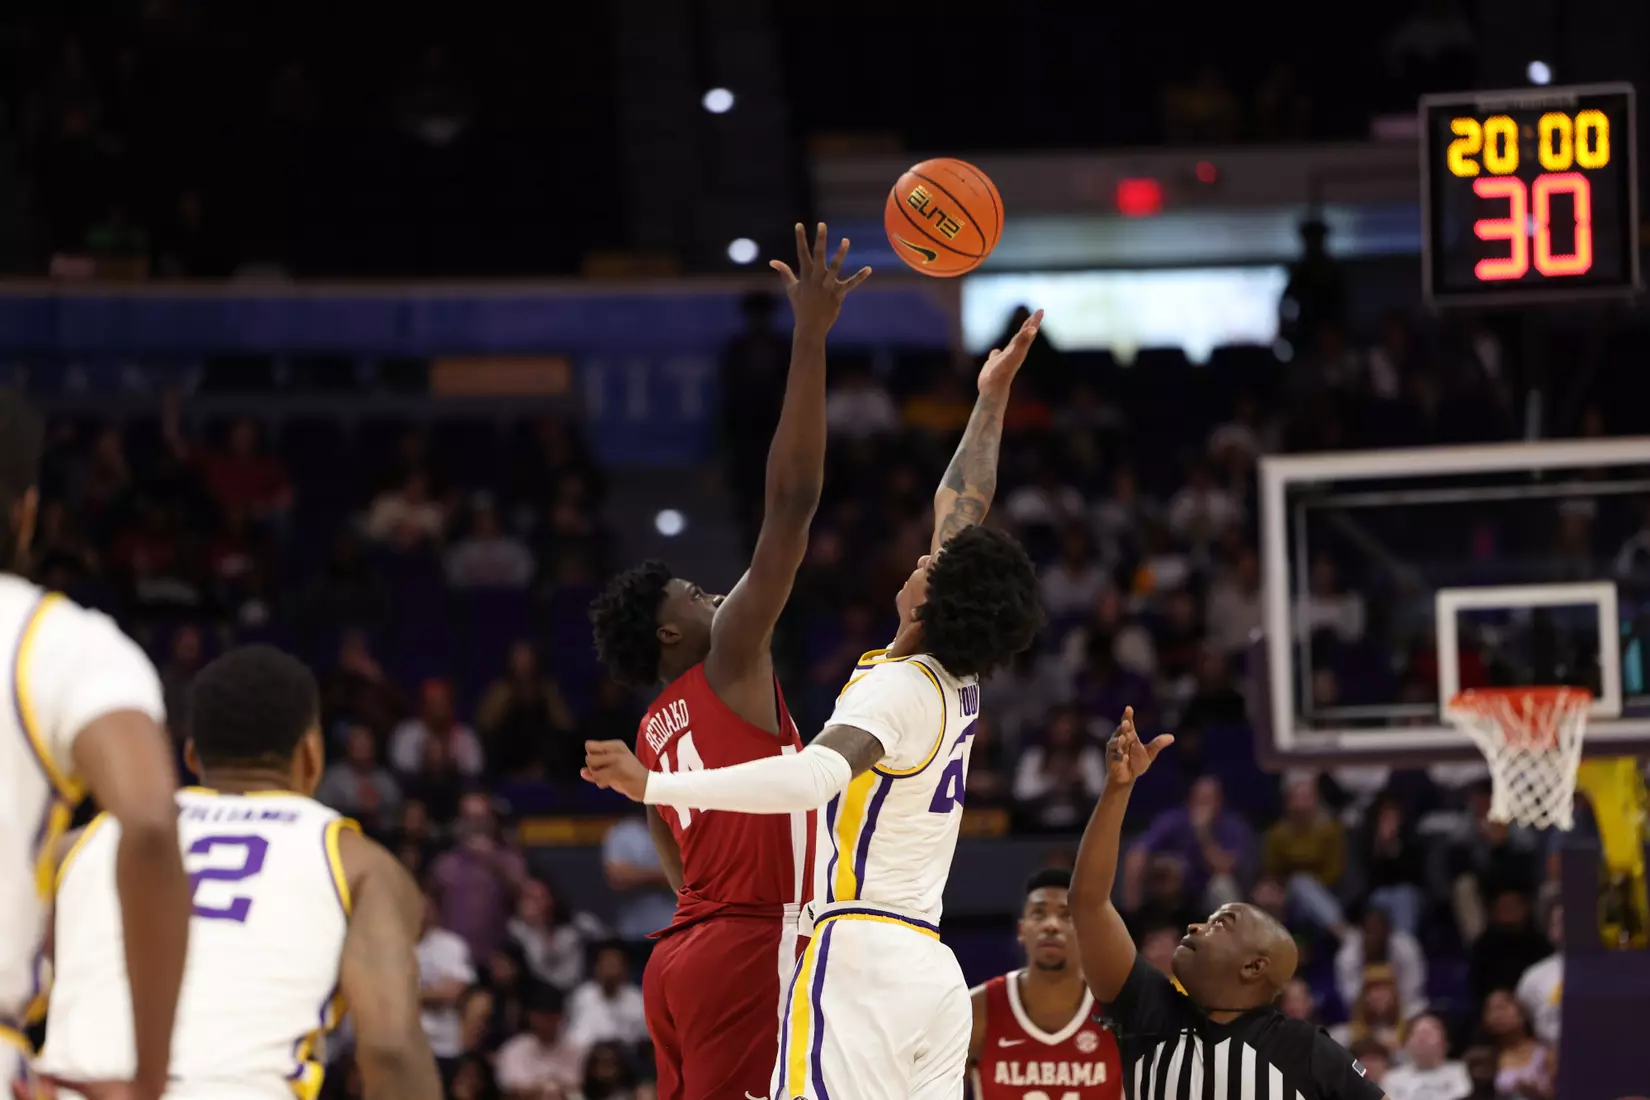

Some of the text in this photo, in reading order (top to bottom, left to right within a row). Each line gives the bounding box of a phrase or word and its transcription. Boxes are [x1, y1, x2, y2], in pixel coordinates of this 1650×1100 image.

[907, 188, 961, 239] ELITE
[1473, 171, 1593, 281] 30
[645, 699, 690, 755] BEDIAKO
[187, 834, 269, 923] 2
[994, 1060, 1107, 1087] ALABAMA
